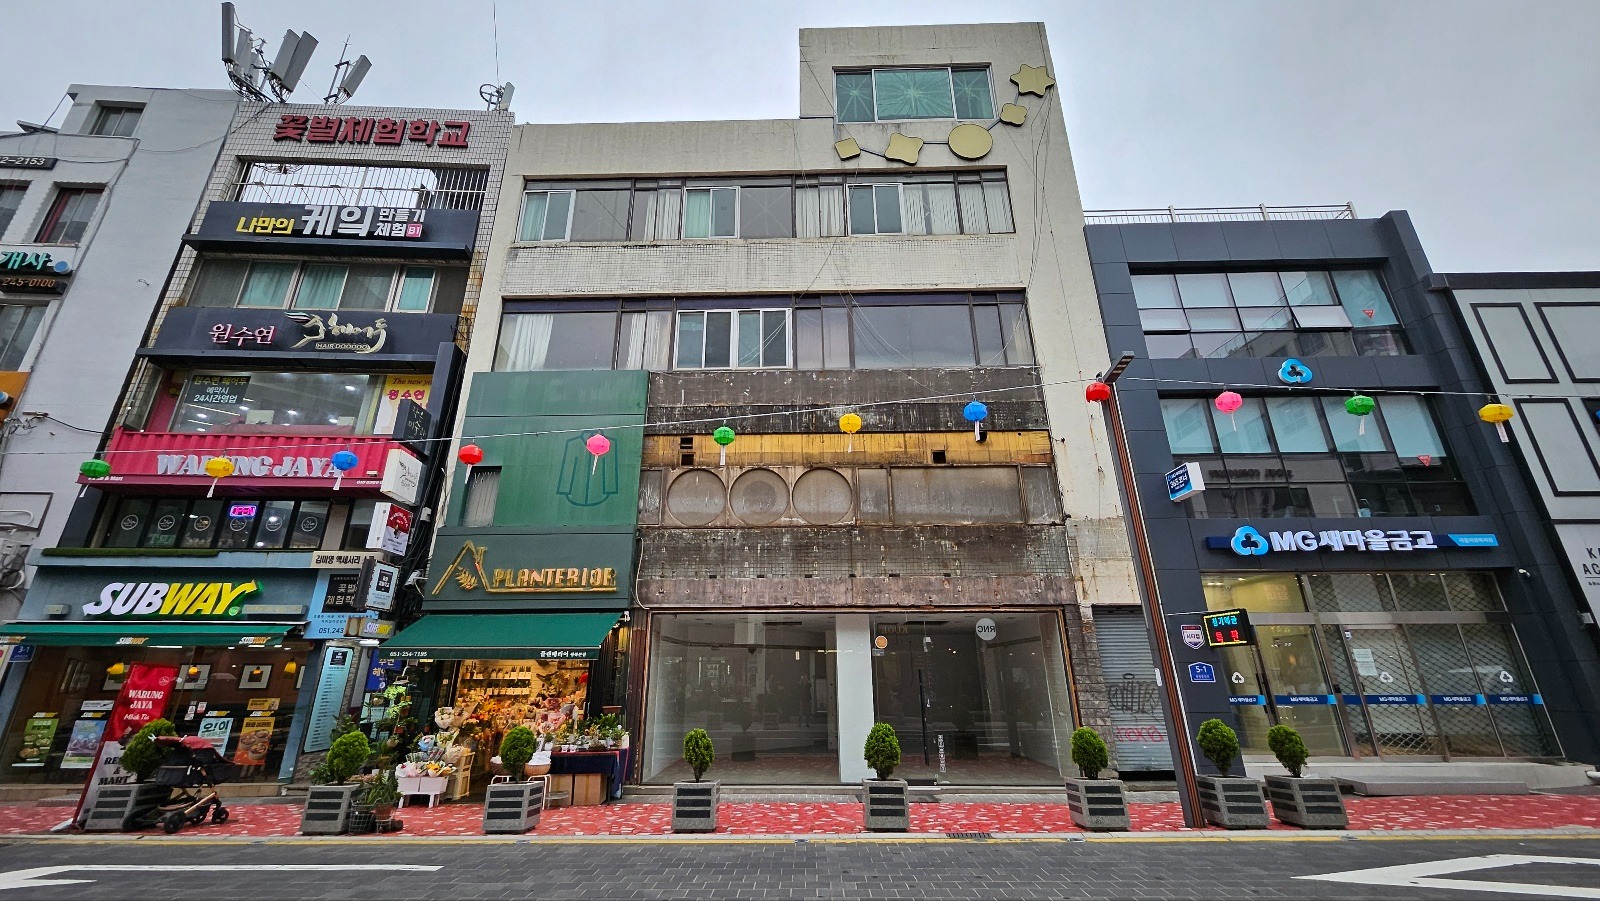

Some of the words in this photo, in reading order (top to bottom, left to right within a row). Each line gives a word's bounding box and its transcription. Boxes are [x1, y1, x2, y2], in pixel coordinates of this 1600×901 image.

[272, 115, 471, 149] 꽃별체험학교
[0, 157, 46, 166] 2-2153
[379, 208, 426, 223] 만들기
[236, 216, 296, 235] 나만의
[373, 222, 406, 237] 체험
[209, 323, 274, 347] 원수연
[194, 395, 238, 404] 24시간영업
[157, 454, 274, 478] WANG
[232, 507, 255, 515] OPEN
[1269, 529, 1438, 552] MG새마을금고
[82, 579, 257, 616] SUBWAY
[1195, 665, 1207, 673] 5-1
[128, 689, 164, 700] WARUNG
[130, 700, 153, 709] JAYA
